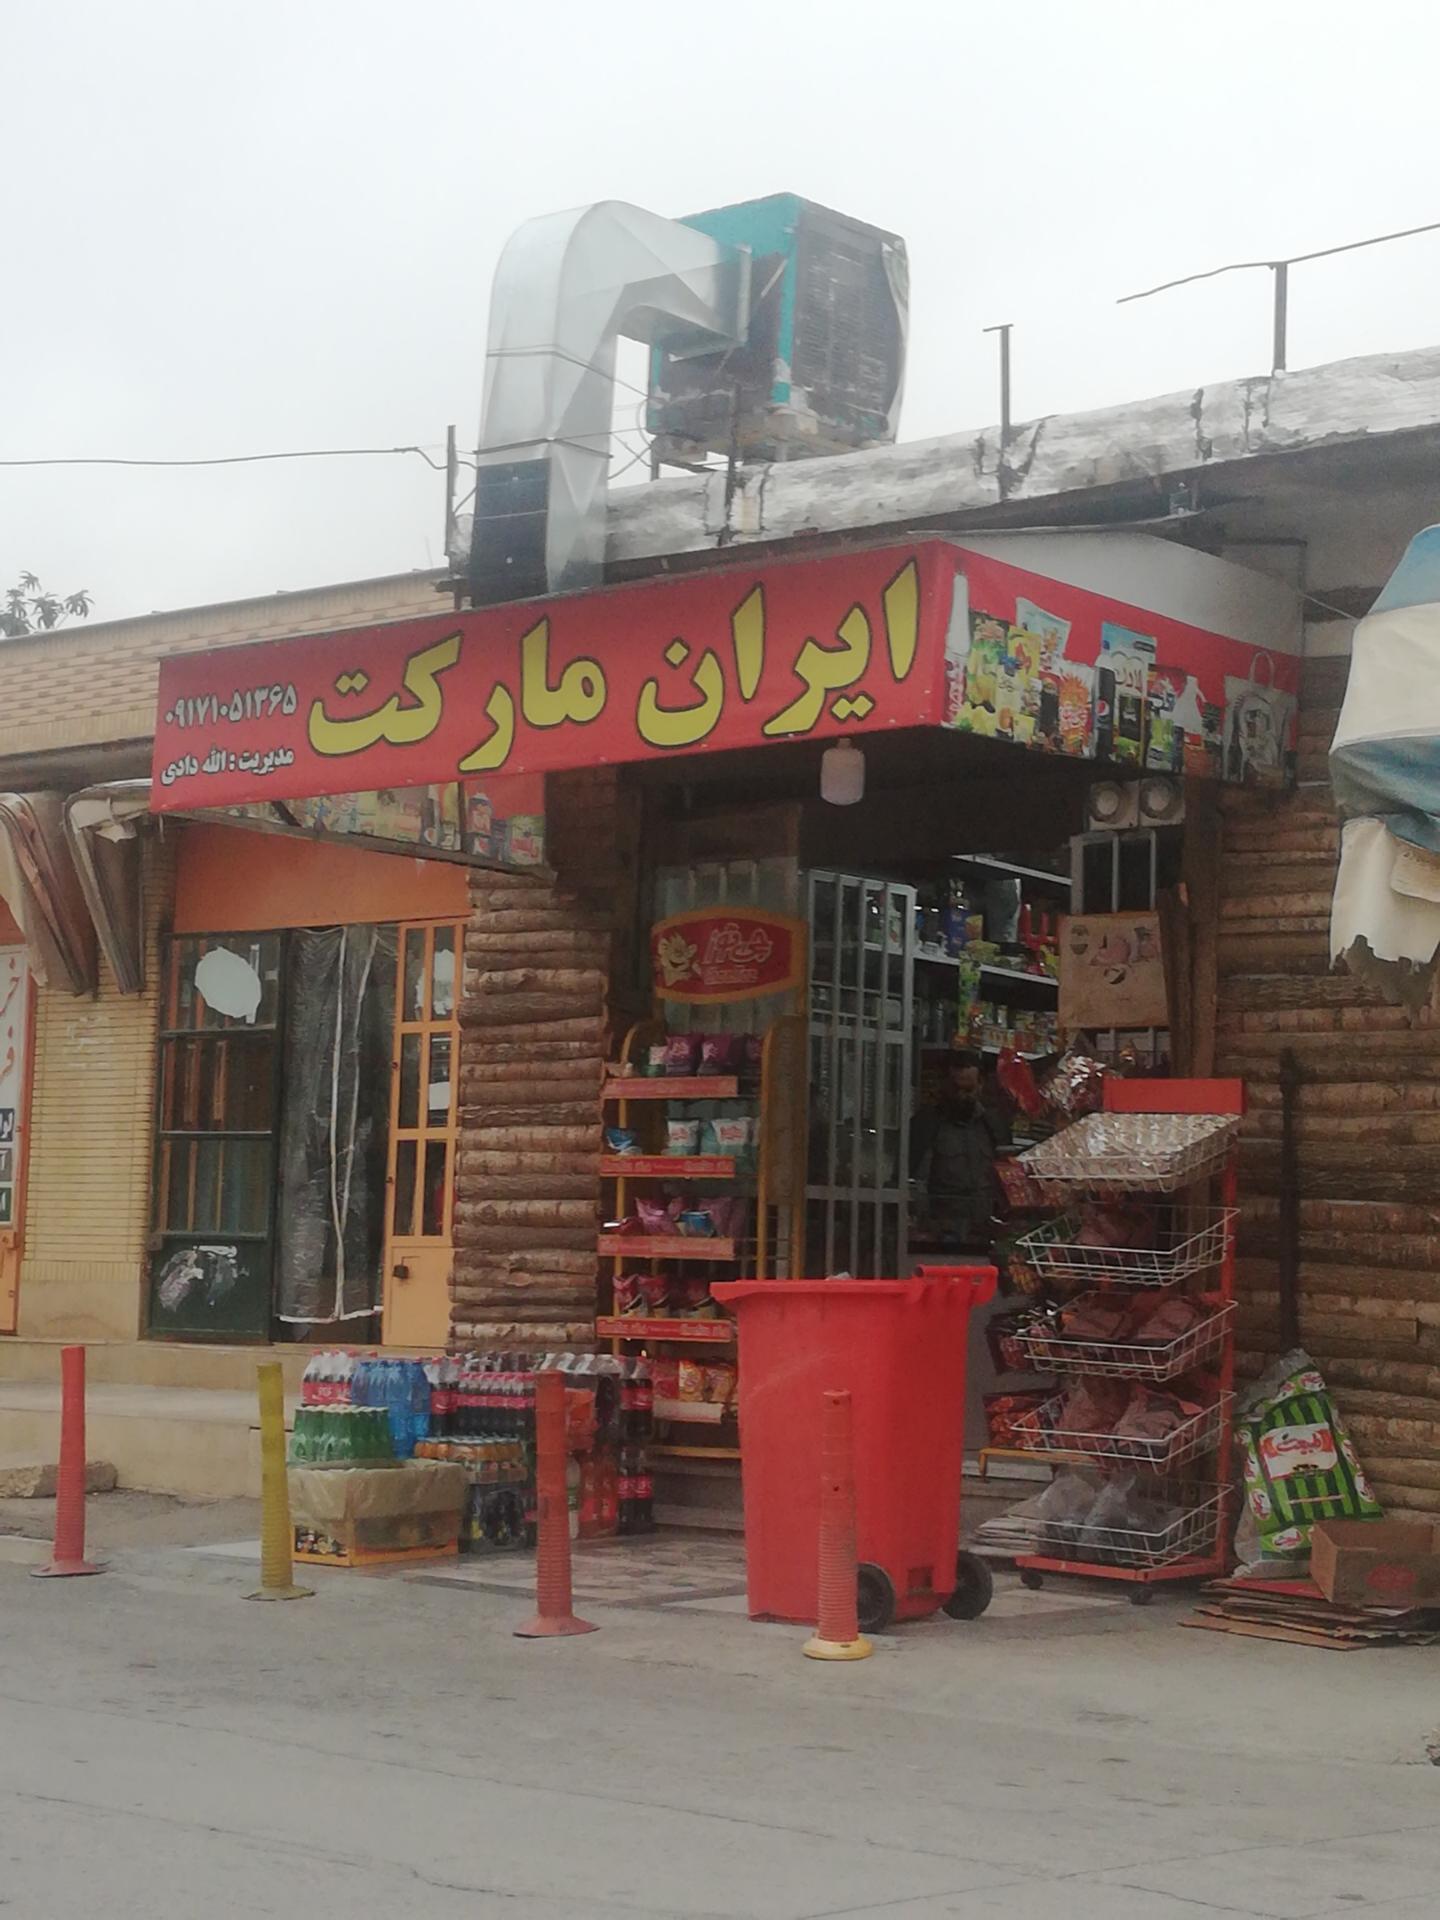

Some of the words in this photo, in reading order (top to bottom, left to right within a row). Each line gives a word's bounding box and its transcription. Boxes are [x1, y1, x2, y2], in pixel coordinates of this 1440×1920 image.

[307, 614, 608, 773] مارکت
[636, 555, 921, 748] ایران
[160, 754, 199, 786] دادی
[202, 744, 227, 774] الله
